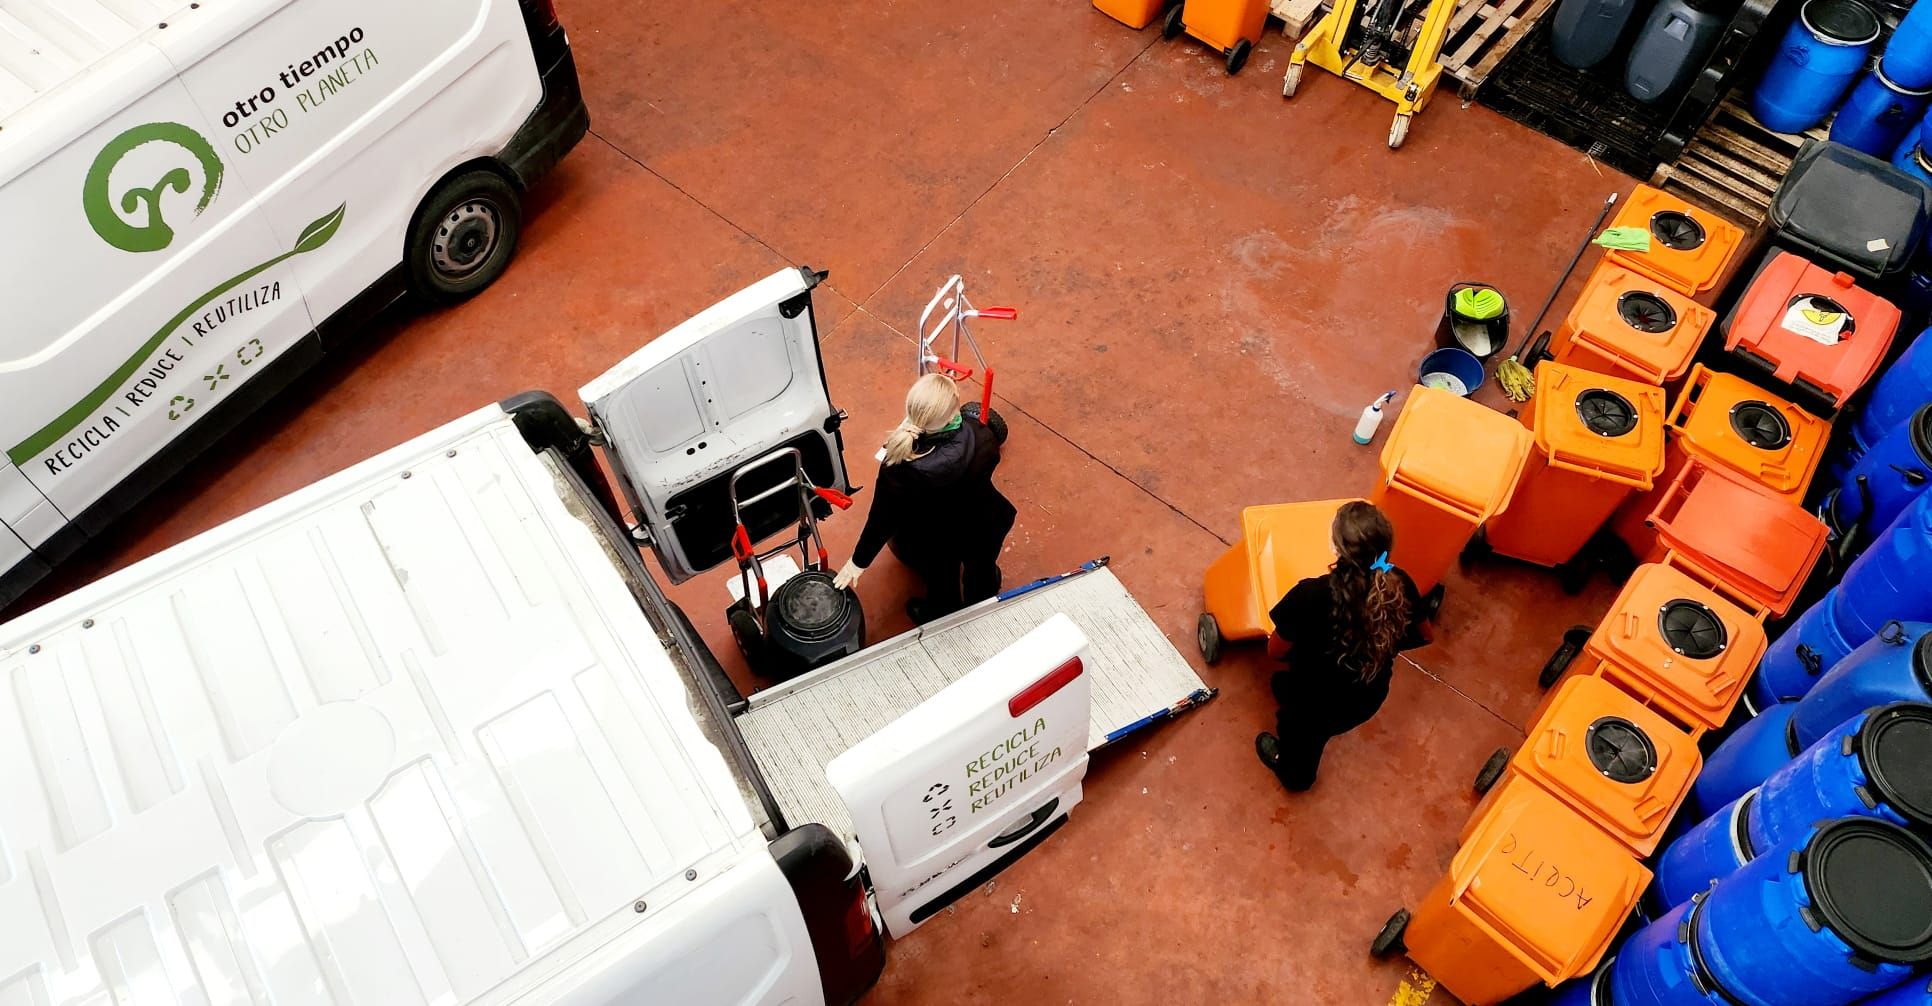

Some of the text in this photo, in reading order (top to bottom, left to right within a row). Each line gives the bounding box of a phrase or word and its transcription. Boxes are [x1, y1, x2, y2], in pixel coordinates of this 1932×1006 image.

[222, 26, 364, 128] otro tiempo
[234, 48, 379, 154] OTRO PLANETA
[44, 415, 120, 476] RECICLA
[125, 348, 184, 407] REDUCE
[192, 281, 281, 338] REUTILIZA
[965, 717, 1046, 778] RECICLA
[968, 740, 1040, 797] REDUCE
[971, 746, 1062, 814] REUTILIZA
